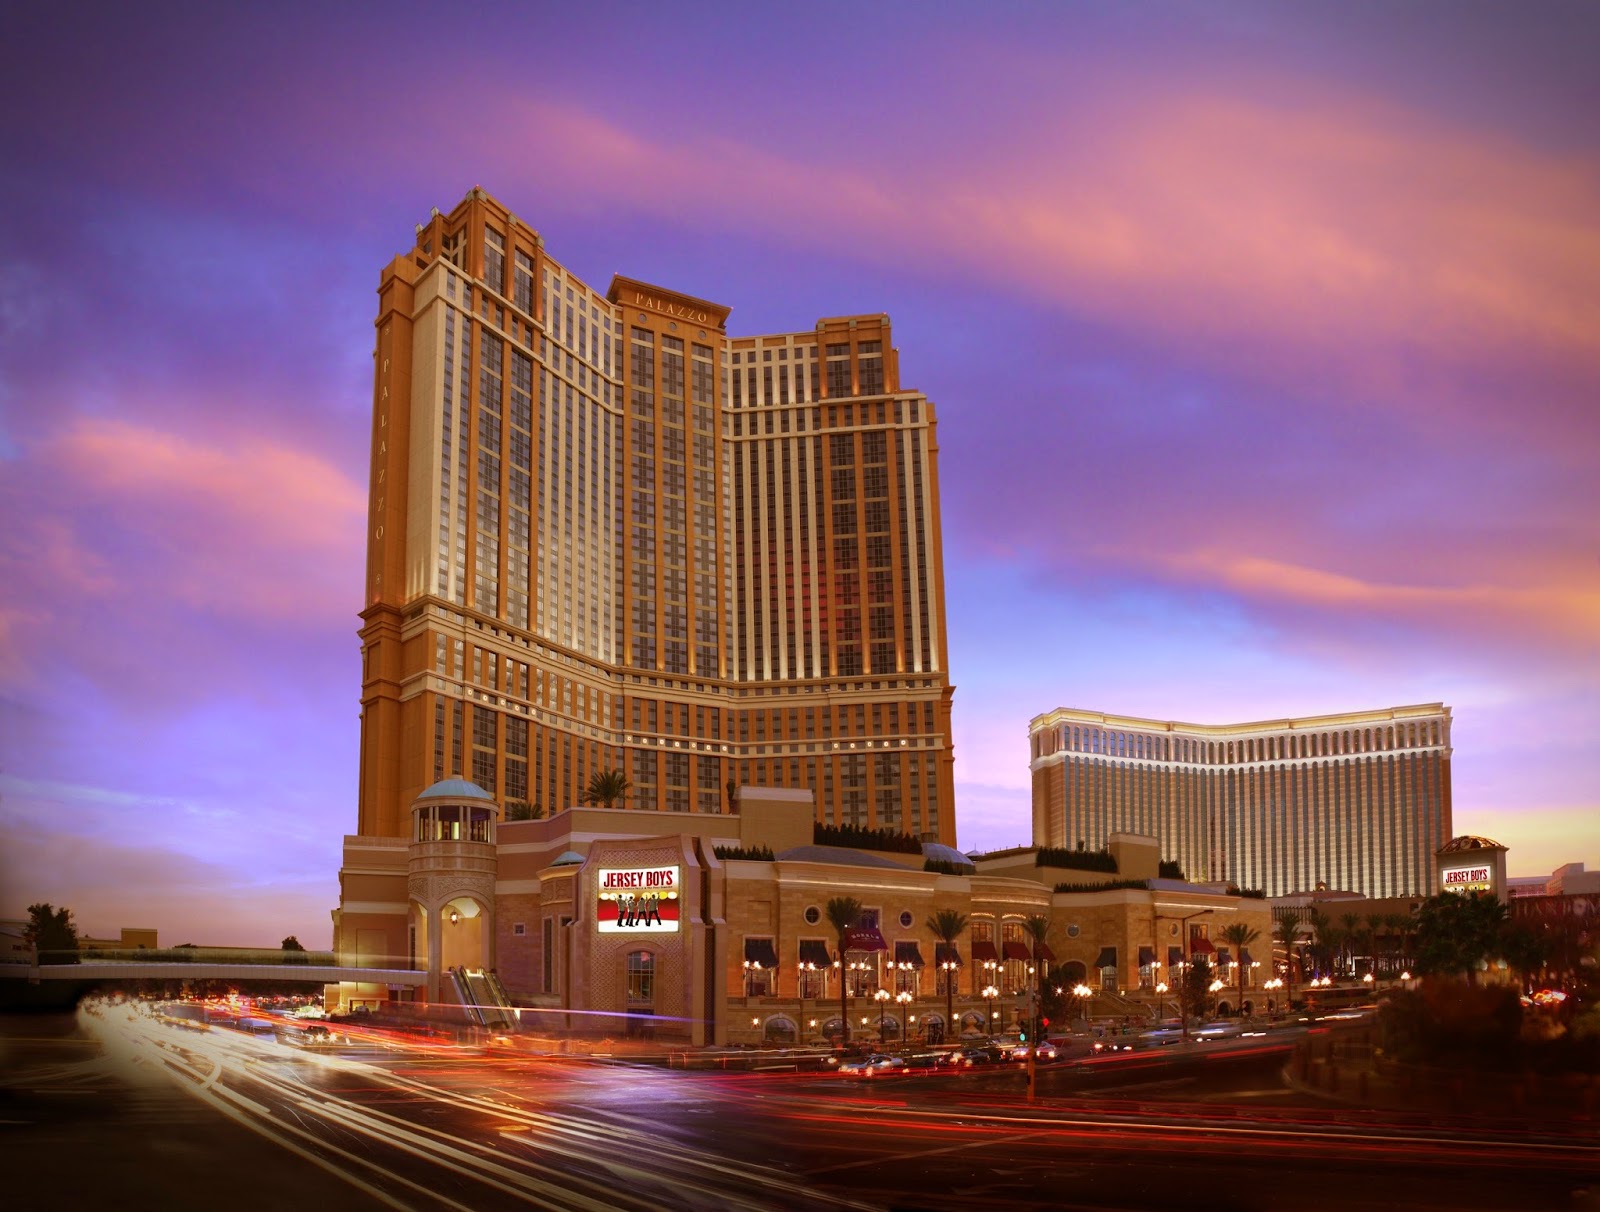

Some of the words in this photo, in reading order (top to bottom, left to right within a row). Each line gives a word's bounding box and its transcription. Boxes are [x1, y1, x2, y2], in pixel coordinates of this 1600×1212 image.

[635, 292, 707, 323] PALAZZO
[376, 359, 389, 540] PALAZZO
[603, 872, 644, 888] JERSEY
[646, 870, 673, 886] BOYS
[1445, 871, 1469, 884] JERSEY
[1471, 869, 1487, 881] BOYS
